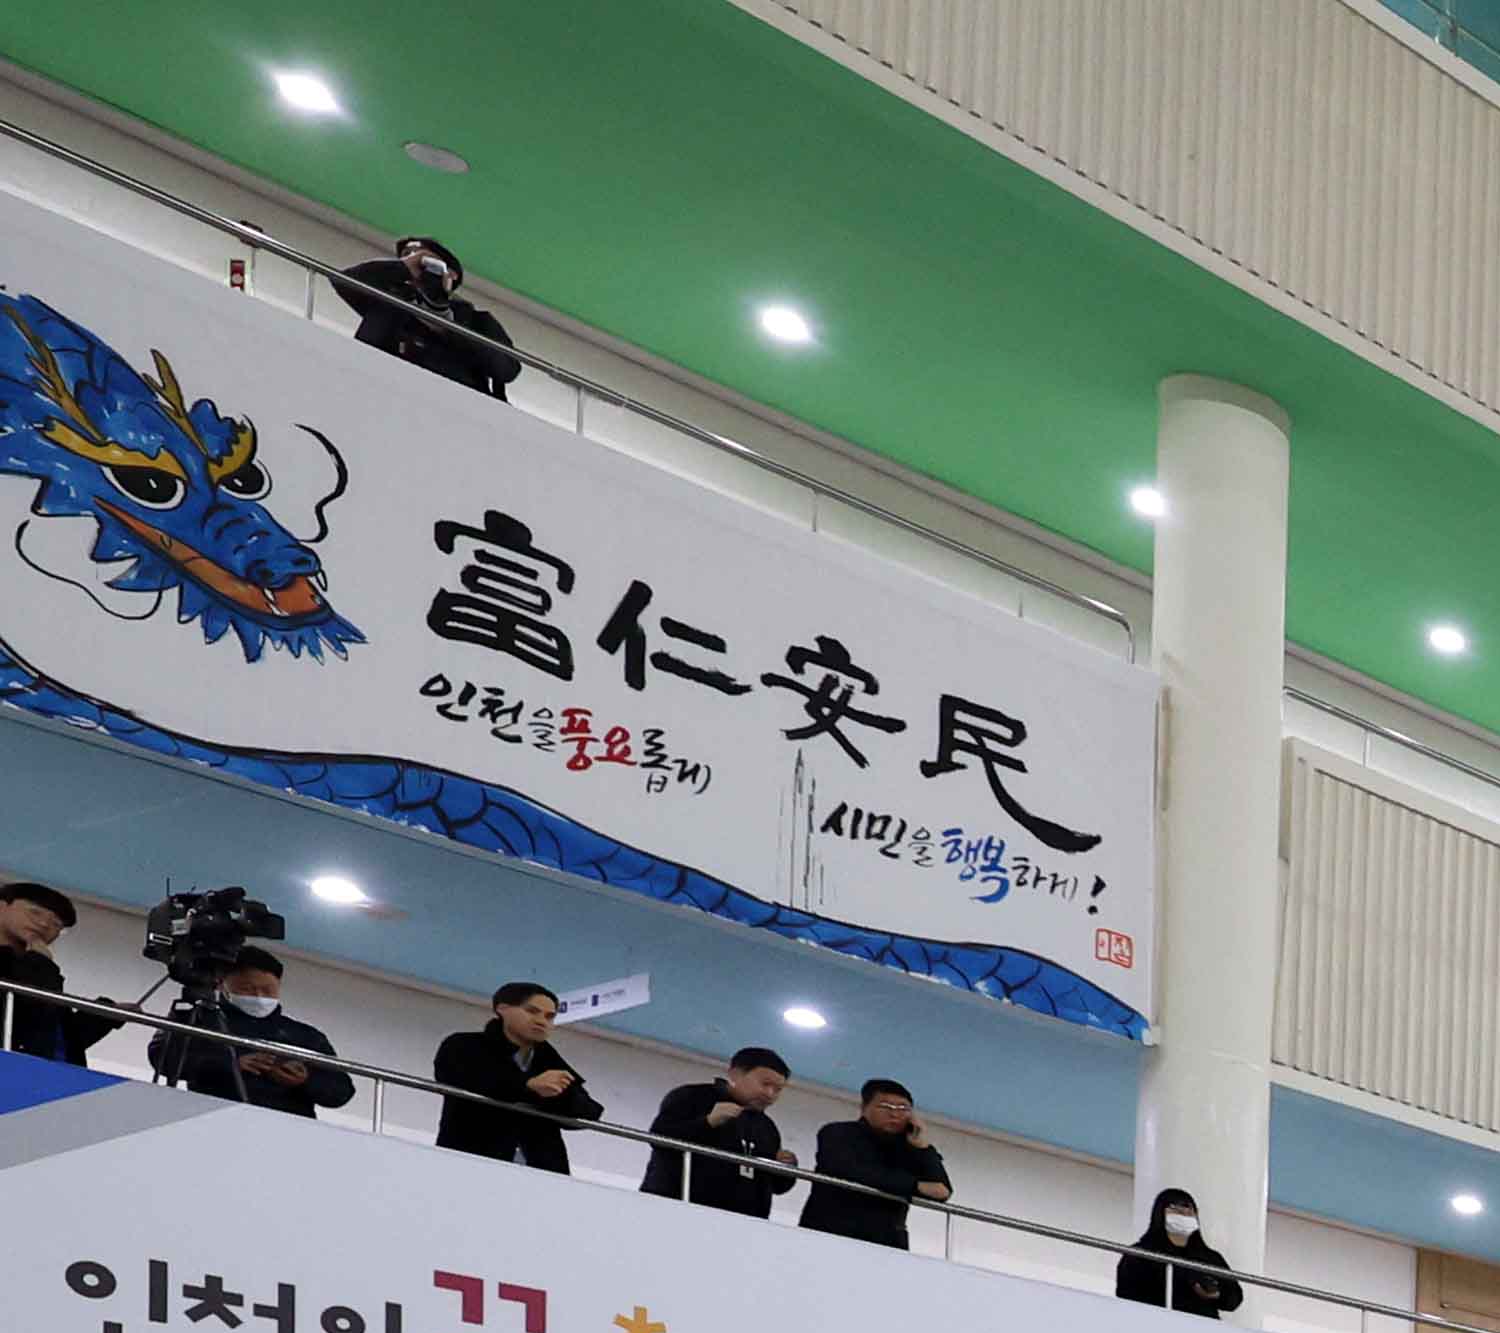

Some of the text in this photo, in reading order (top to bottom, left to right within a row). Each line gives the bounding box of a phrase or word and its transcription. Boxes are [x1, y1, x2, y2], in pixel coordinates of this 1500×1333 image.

[419, 673, 712, 794] 인천을 풍요롭게
[427, 510, 1101, 853] 富仁安民
[821, 800, 936, 868] 시민을
